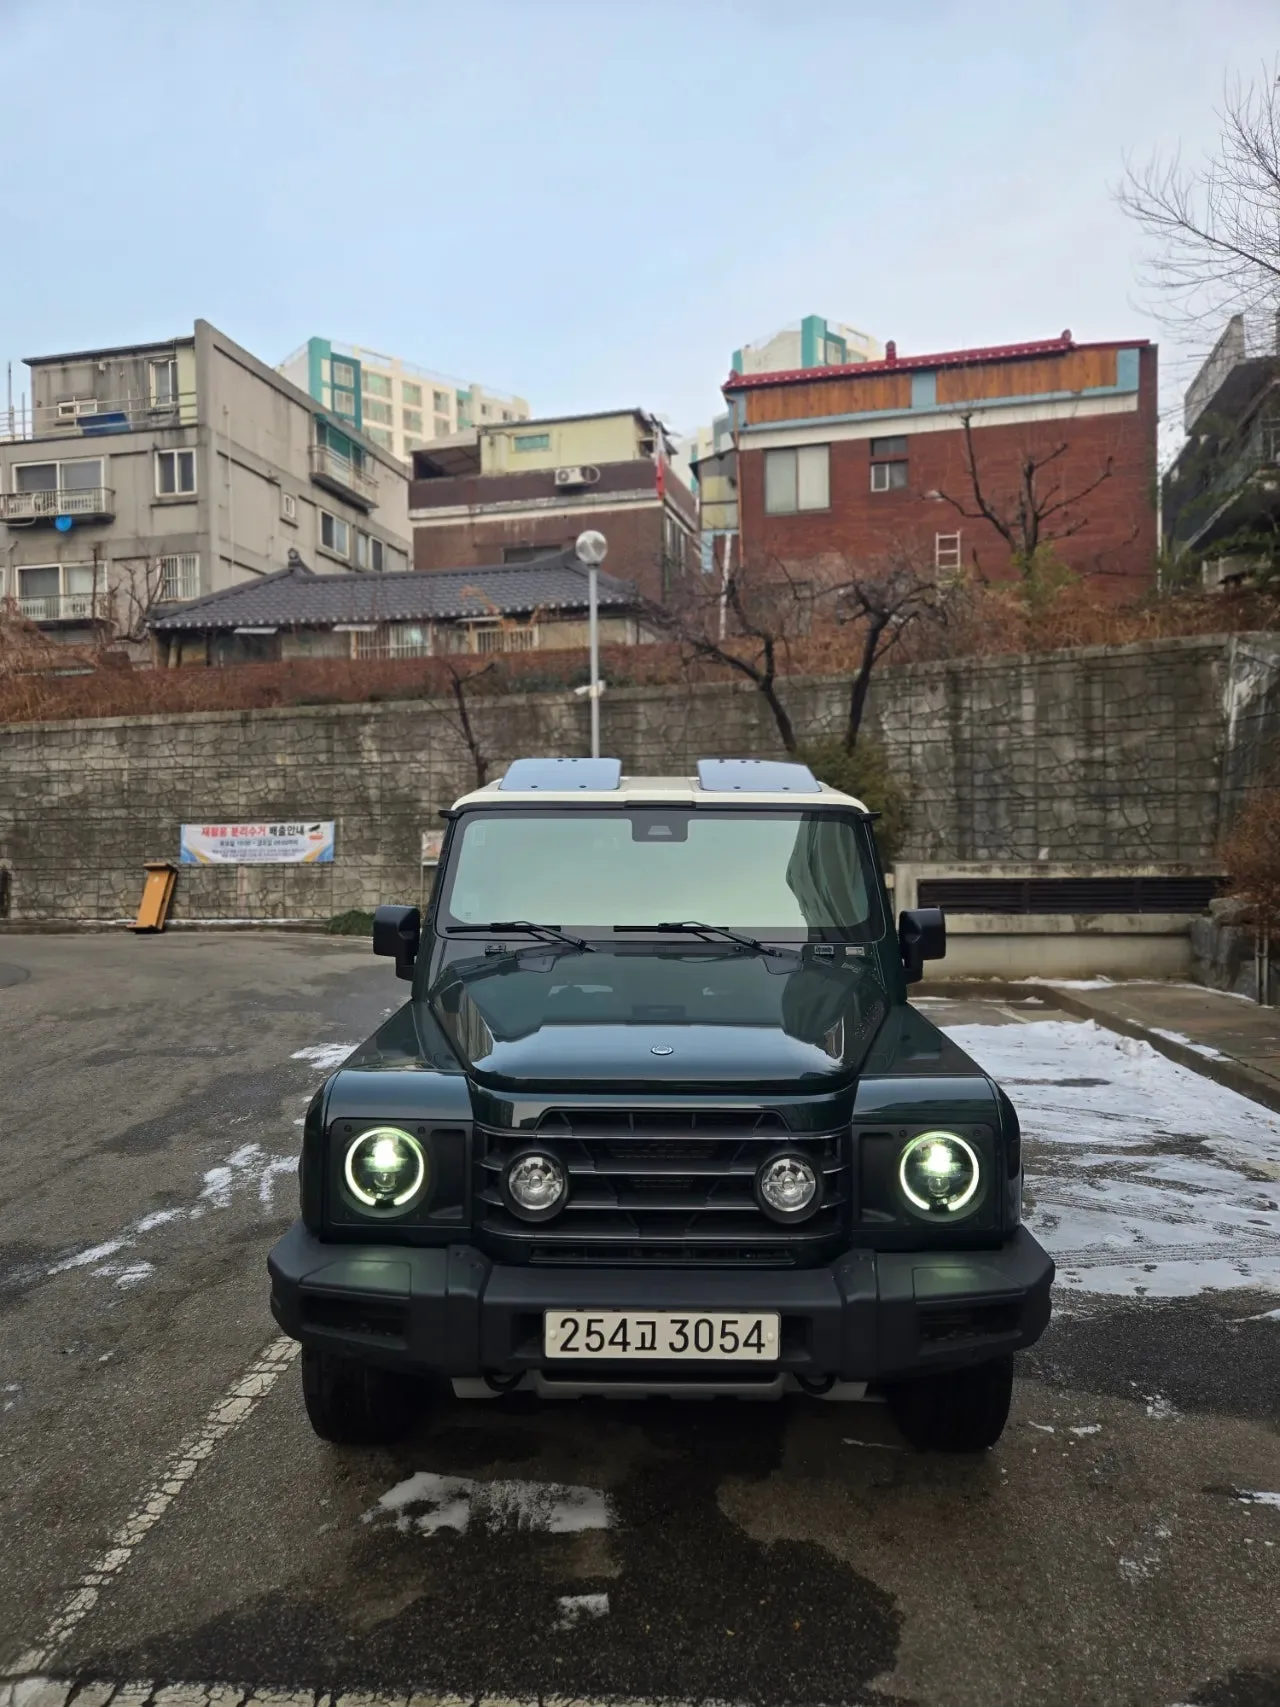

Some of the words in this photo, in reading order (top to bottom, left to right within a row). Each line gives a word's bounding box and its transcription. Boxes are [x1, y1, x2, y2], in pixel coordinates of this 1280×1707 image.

[202, 826, 227, 837] 재활용
[231, 825, 266, 836] 분리수거
[269, 824, 304, 835] 배출안내
[560, 1317, 657, 1353] 254고
[668, 1318, 766, 1354] 3054
